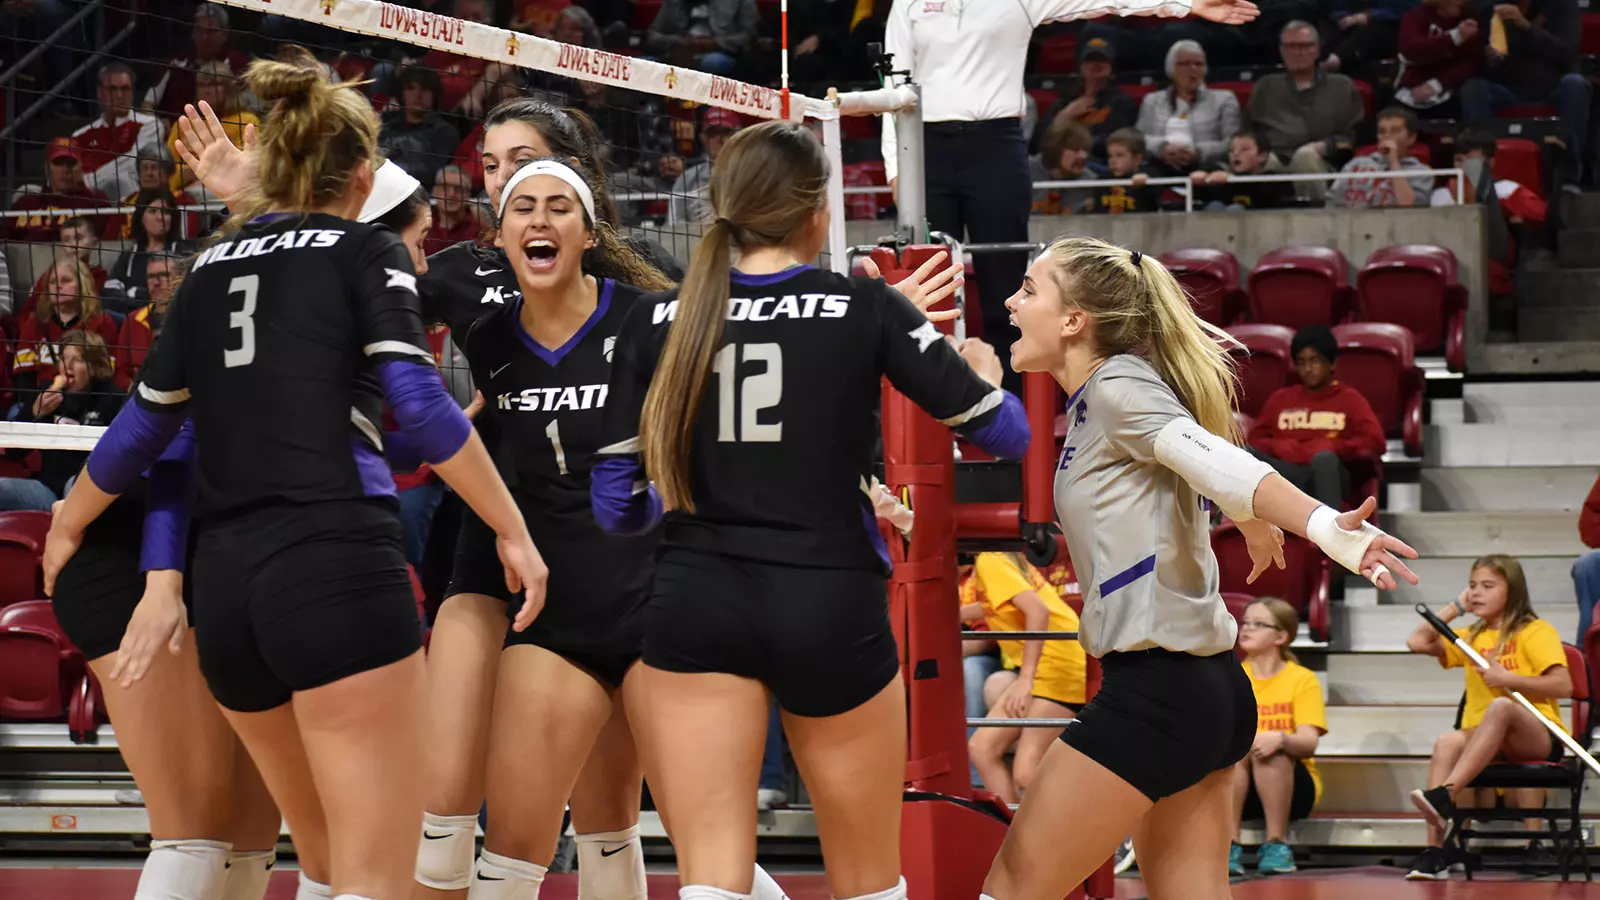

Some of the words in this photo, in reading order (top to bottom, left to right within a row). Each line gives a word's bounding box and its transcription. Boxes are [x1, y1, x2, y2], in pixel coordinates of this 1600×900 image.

[379, 3, 418, 35] IOWA
[421, 13, 465, 45] STATE
[557, 43, 590, 73] IOWA
[591, 50, 631, 81] STATE
[709, 75, 739, 104] IOWA
[739, 82, 774, 111] STATE
[191, 229, 346, 273] WILDCATS
[224, 274, 260, 368] 3
[652, 293, 851, 325] WDCATS
[712, 342, 783, 442] 12
[545, 418, 570, 475] 1
